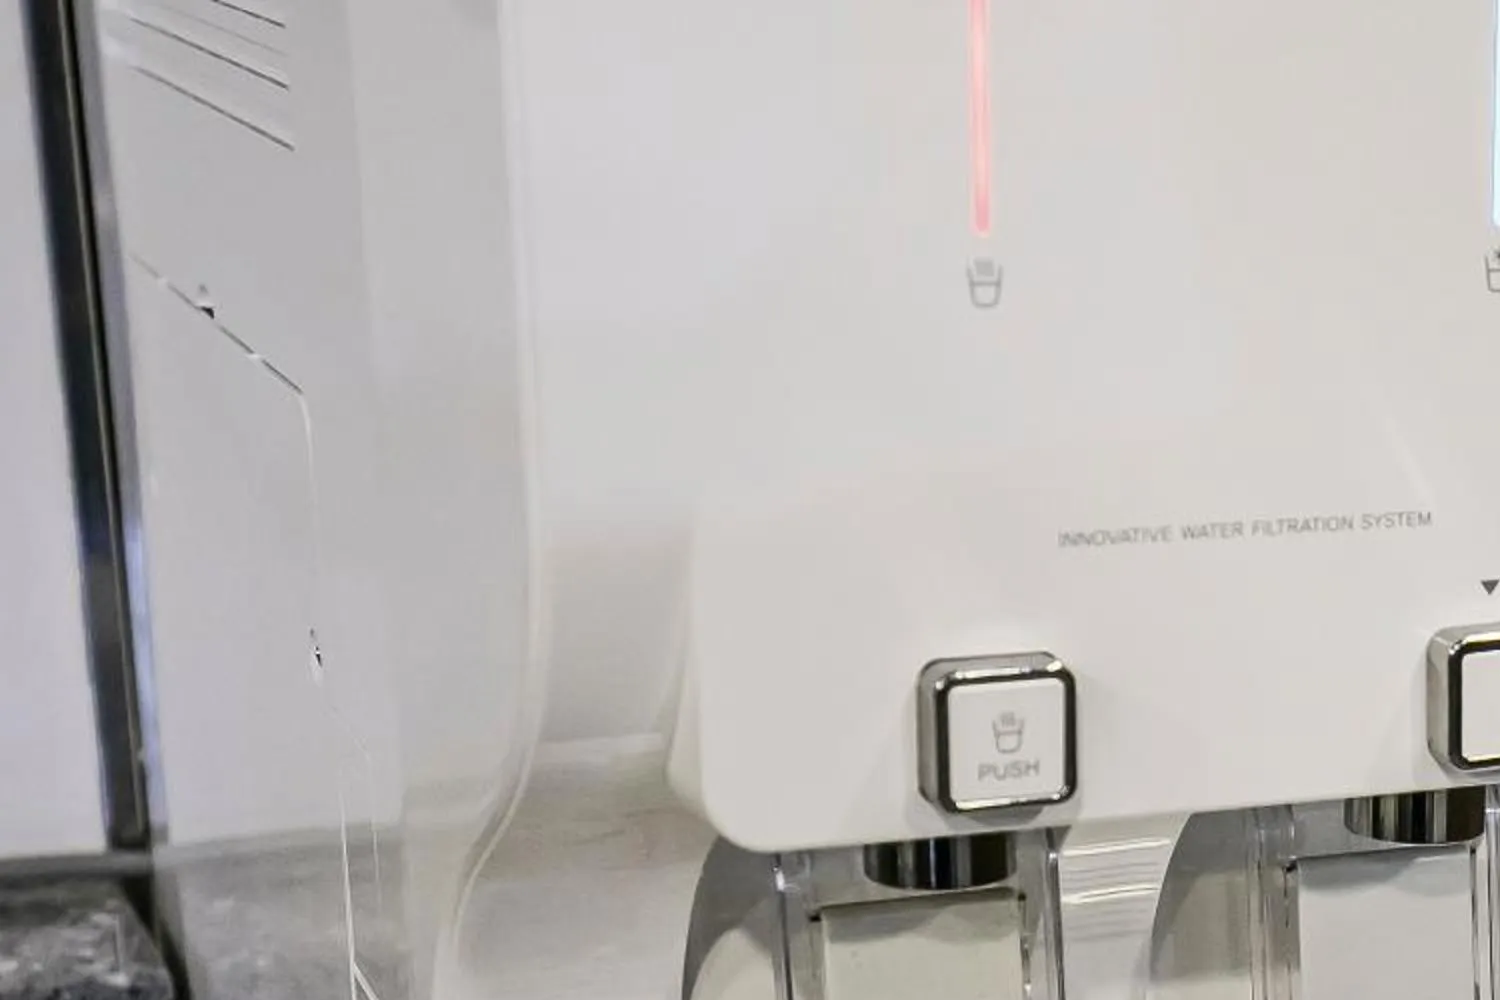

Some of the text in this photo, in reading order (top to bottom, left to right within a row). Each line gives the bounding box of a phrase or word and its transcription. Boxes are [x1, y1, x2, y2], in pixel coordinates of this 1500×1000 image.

[1058, 511, 1432, 548] INNOVATIVE WATER FILTRATION SYSTEM
[977, 759, 1040, 781] PUSH
